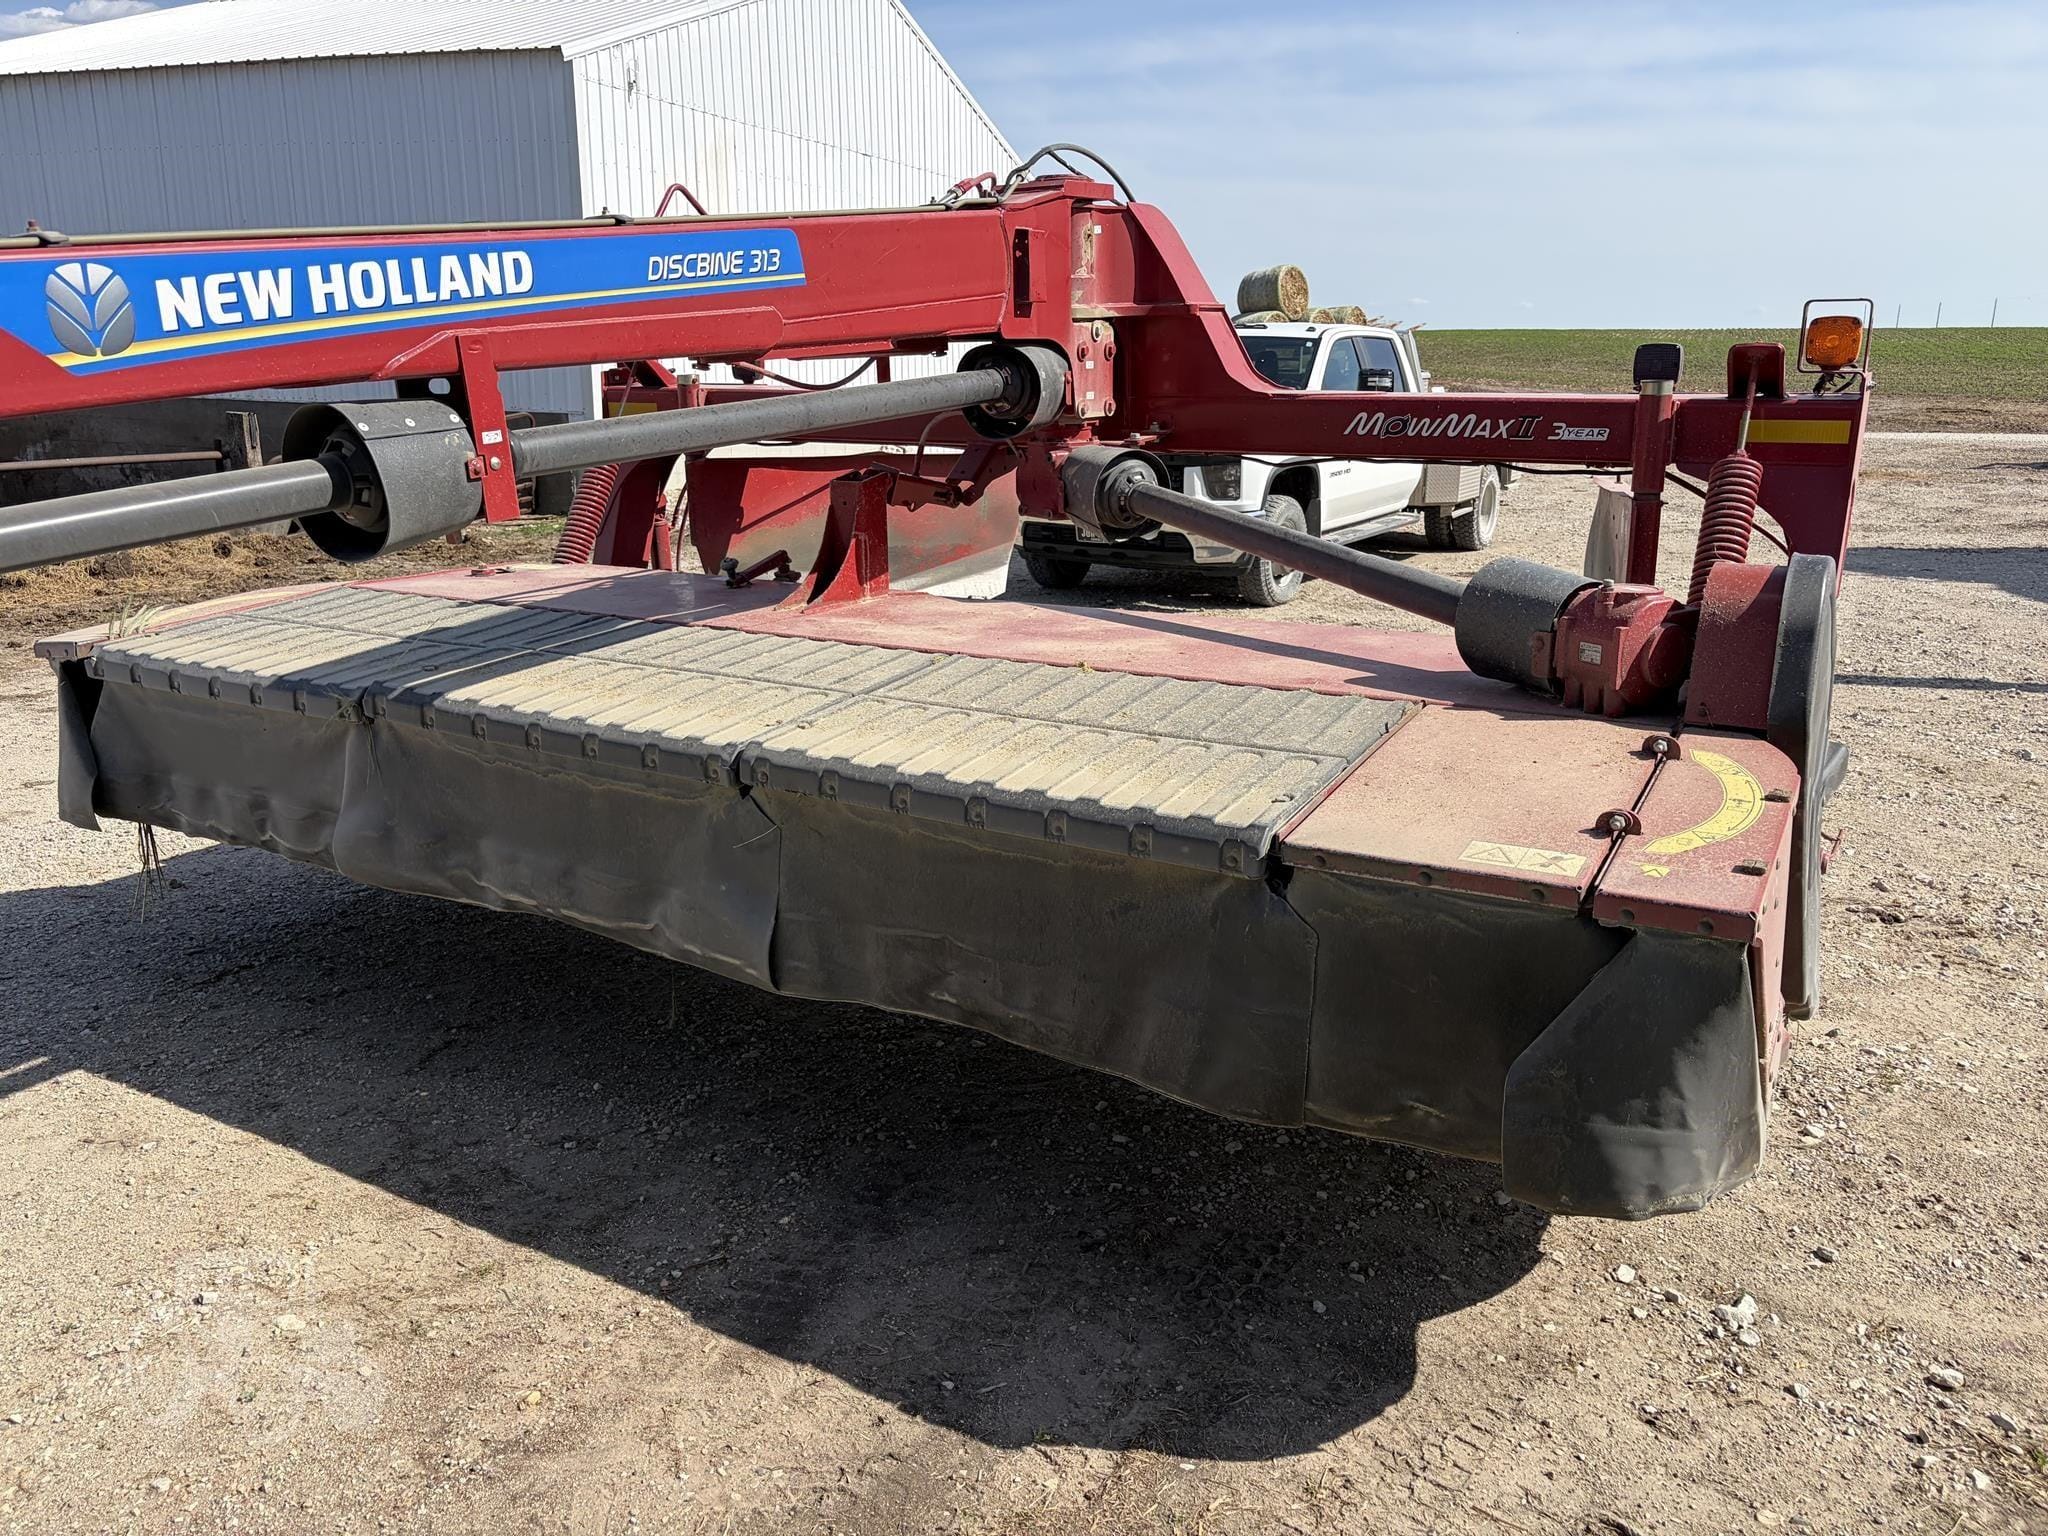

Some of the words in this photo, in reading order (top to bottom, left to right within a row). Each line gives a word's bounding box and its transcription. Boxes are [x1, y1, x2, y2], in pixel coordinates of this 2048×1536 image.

[155, 267, 293, 331] NEW
[307, 250, 534, 314] HOLLAND
[647, 250, 744, 281] DISCBINE
[749, 248, 781, 274] 313
